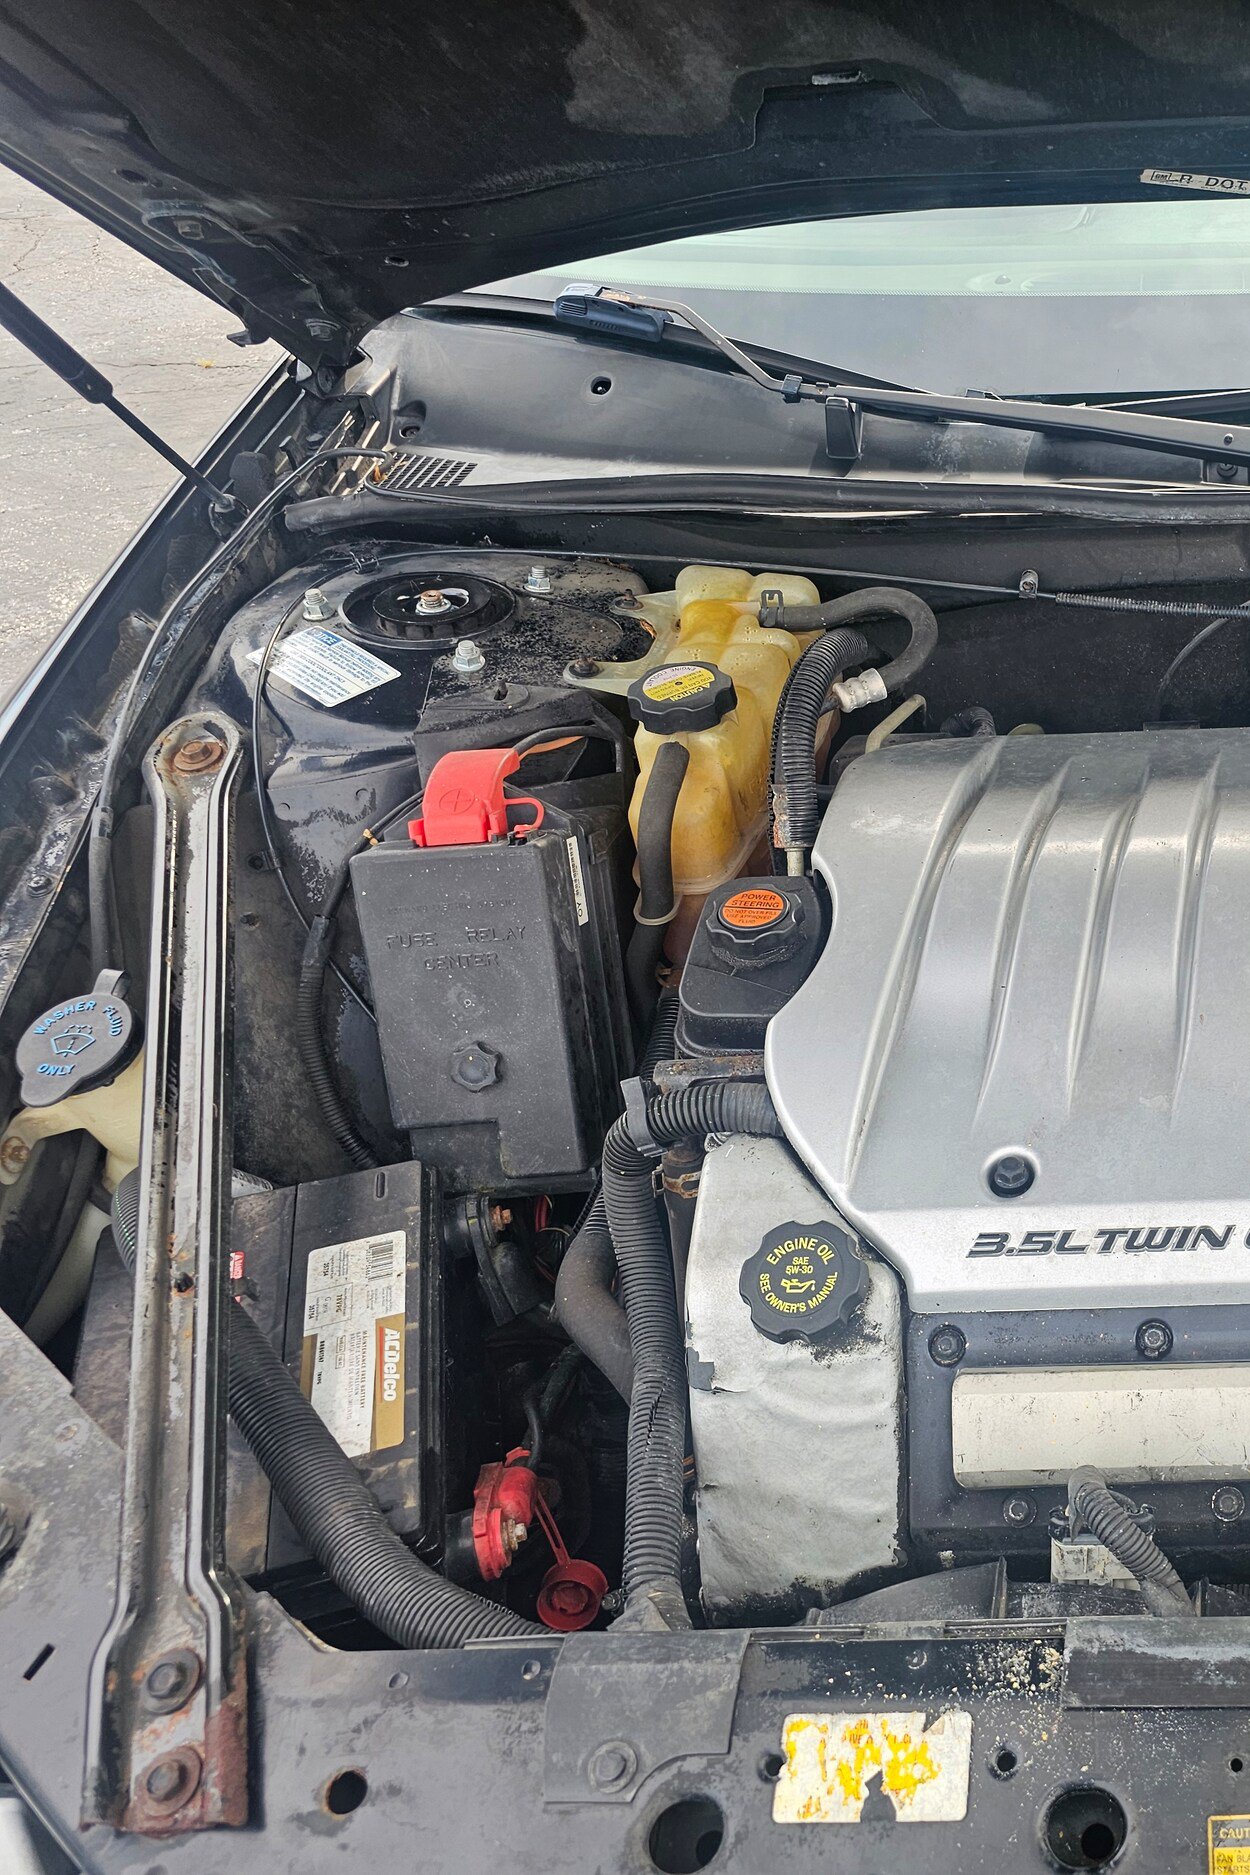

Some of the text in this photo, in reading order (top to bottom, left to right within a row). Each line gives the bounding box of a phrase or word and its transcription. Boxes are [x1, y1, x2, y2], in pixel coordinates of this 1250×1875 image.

[1204, 177, 1249, 191] DOT
[731, 900, 779, 908] STEERING
[741, 893, 777, 901] POWER
[386, 926, 526, 949] FUSE RELAY
[424, 952, 500, 971] CENTER
[33, 1000, 123, 1037] WASHER FLUID
[36, 1063, 77, 1077] ONLY
[966, 1230, 1089, 1258] 3.5L
[1096, 1225, 1236, 1255] TWIN
[766, 1237, 835, 1265] ENGINE OIL
[792, 1256, 810, 1266] SAE
[785, 1265, 814, 1276] 5W-30
[759, 1271, 838, 1313] SEE OWNER'S MANUAL
[383, 1327, 401, 1402] ACDelco
[1216, 1853, 1233, 1863] FAN
[1216, 1865, 1250, 1874] STARTS
